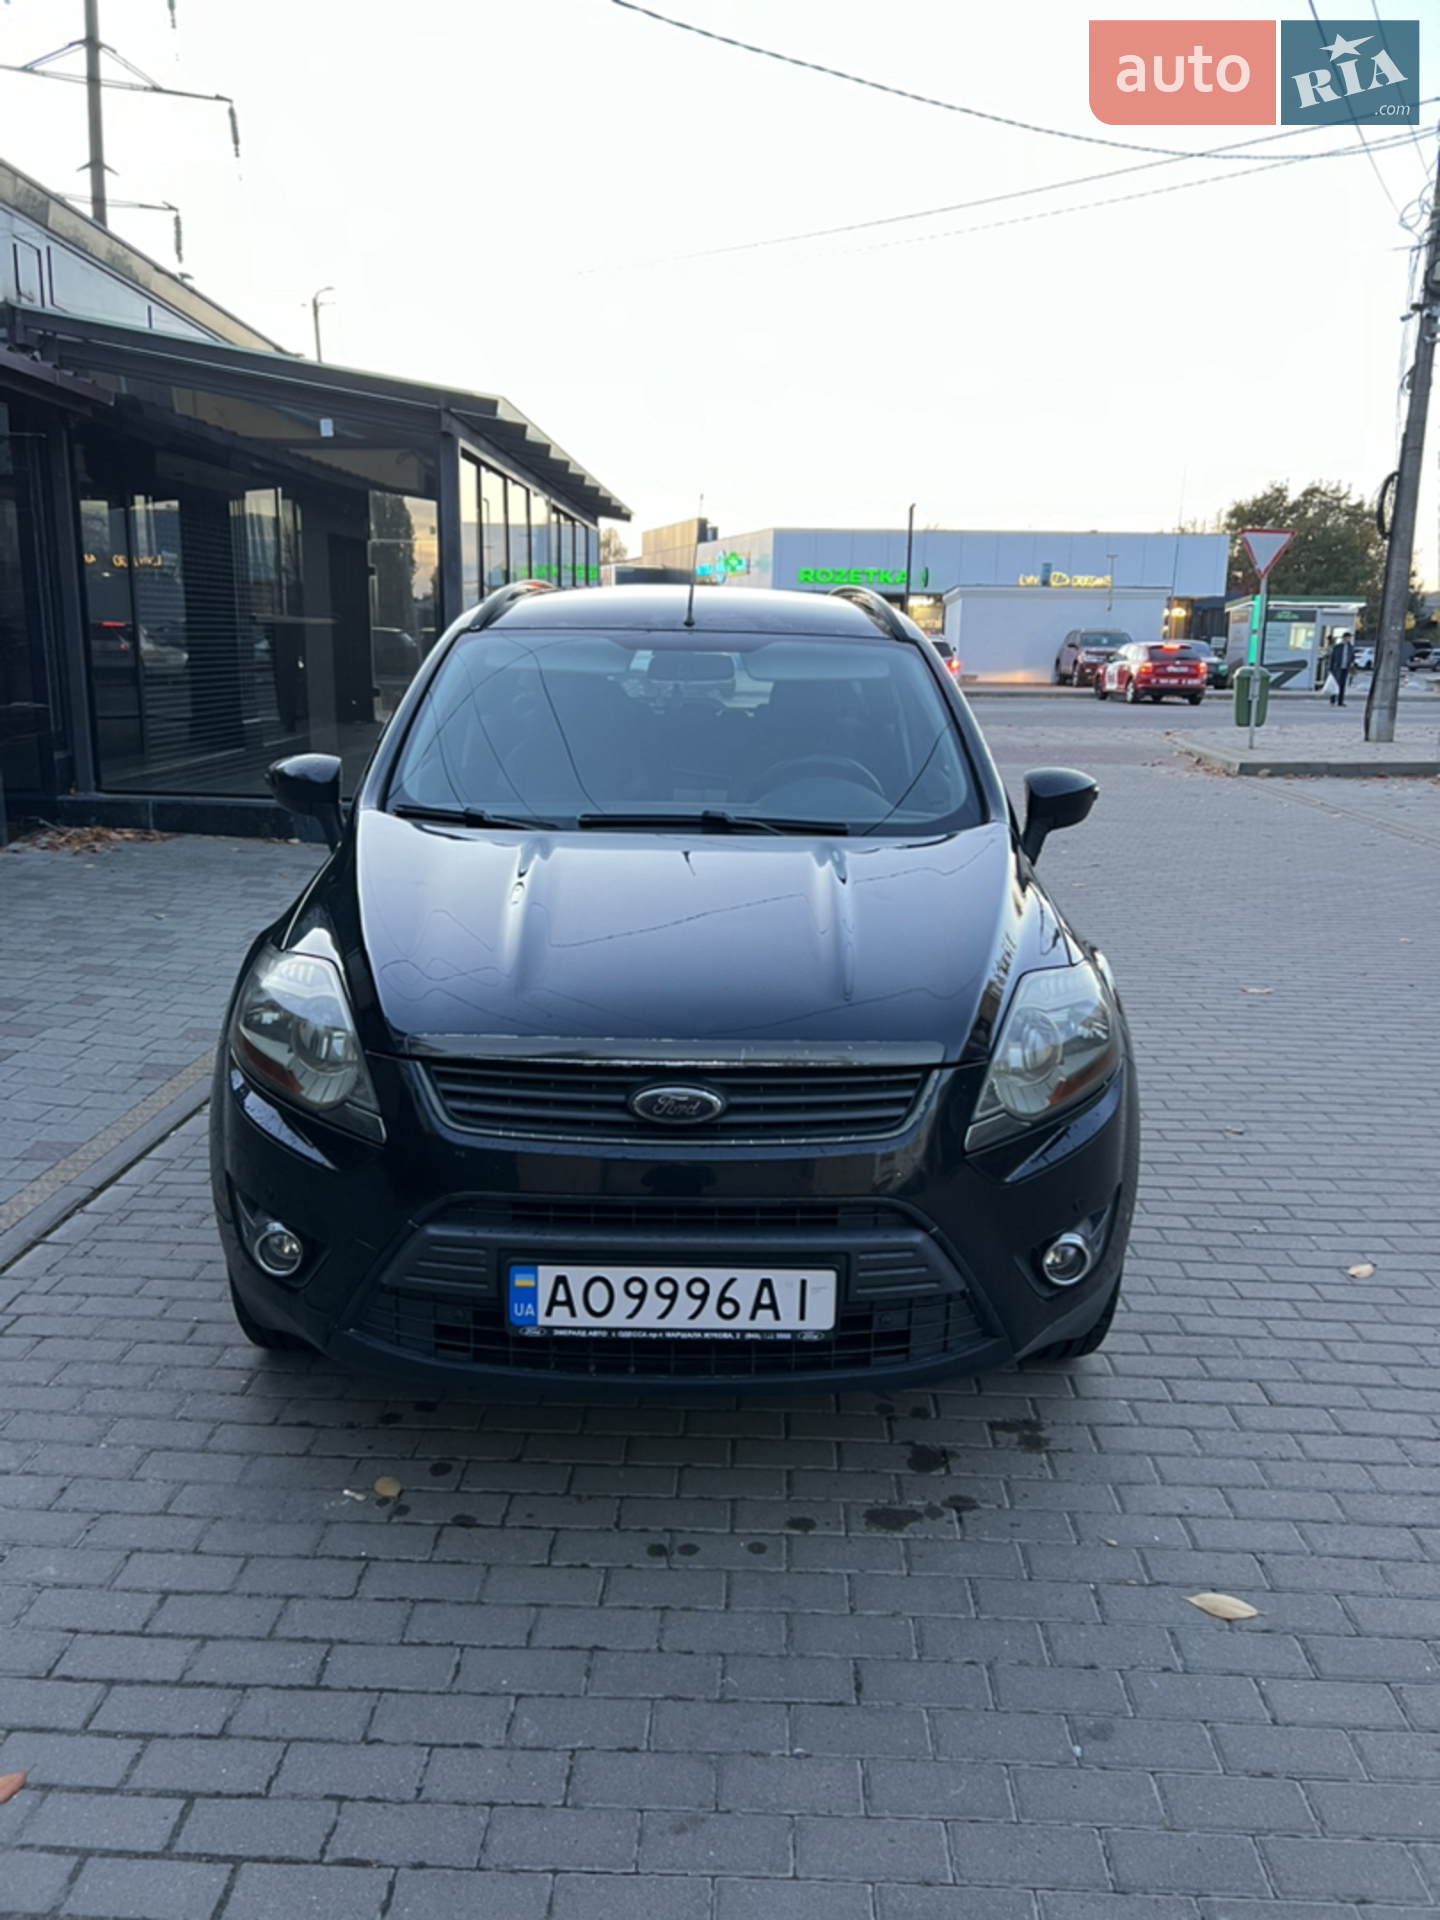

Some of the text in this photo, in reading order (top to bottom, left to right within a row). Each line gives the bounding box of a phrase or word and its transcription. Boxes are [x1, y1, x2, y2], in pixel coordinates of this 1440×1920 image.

[798, 568, 908, 585] ROZETKA
[652, 1094, 702, 1116] Ford
[514, 1303, 536, 1317] UA
